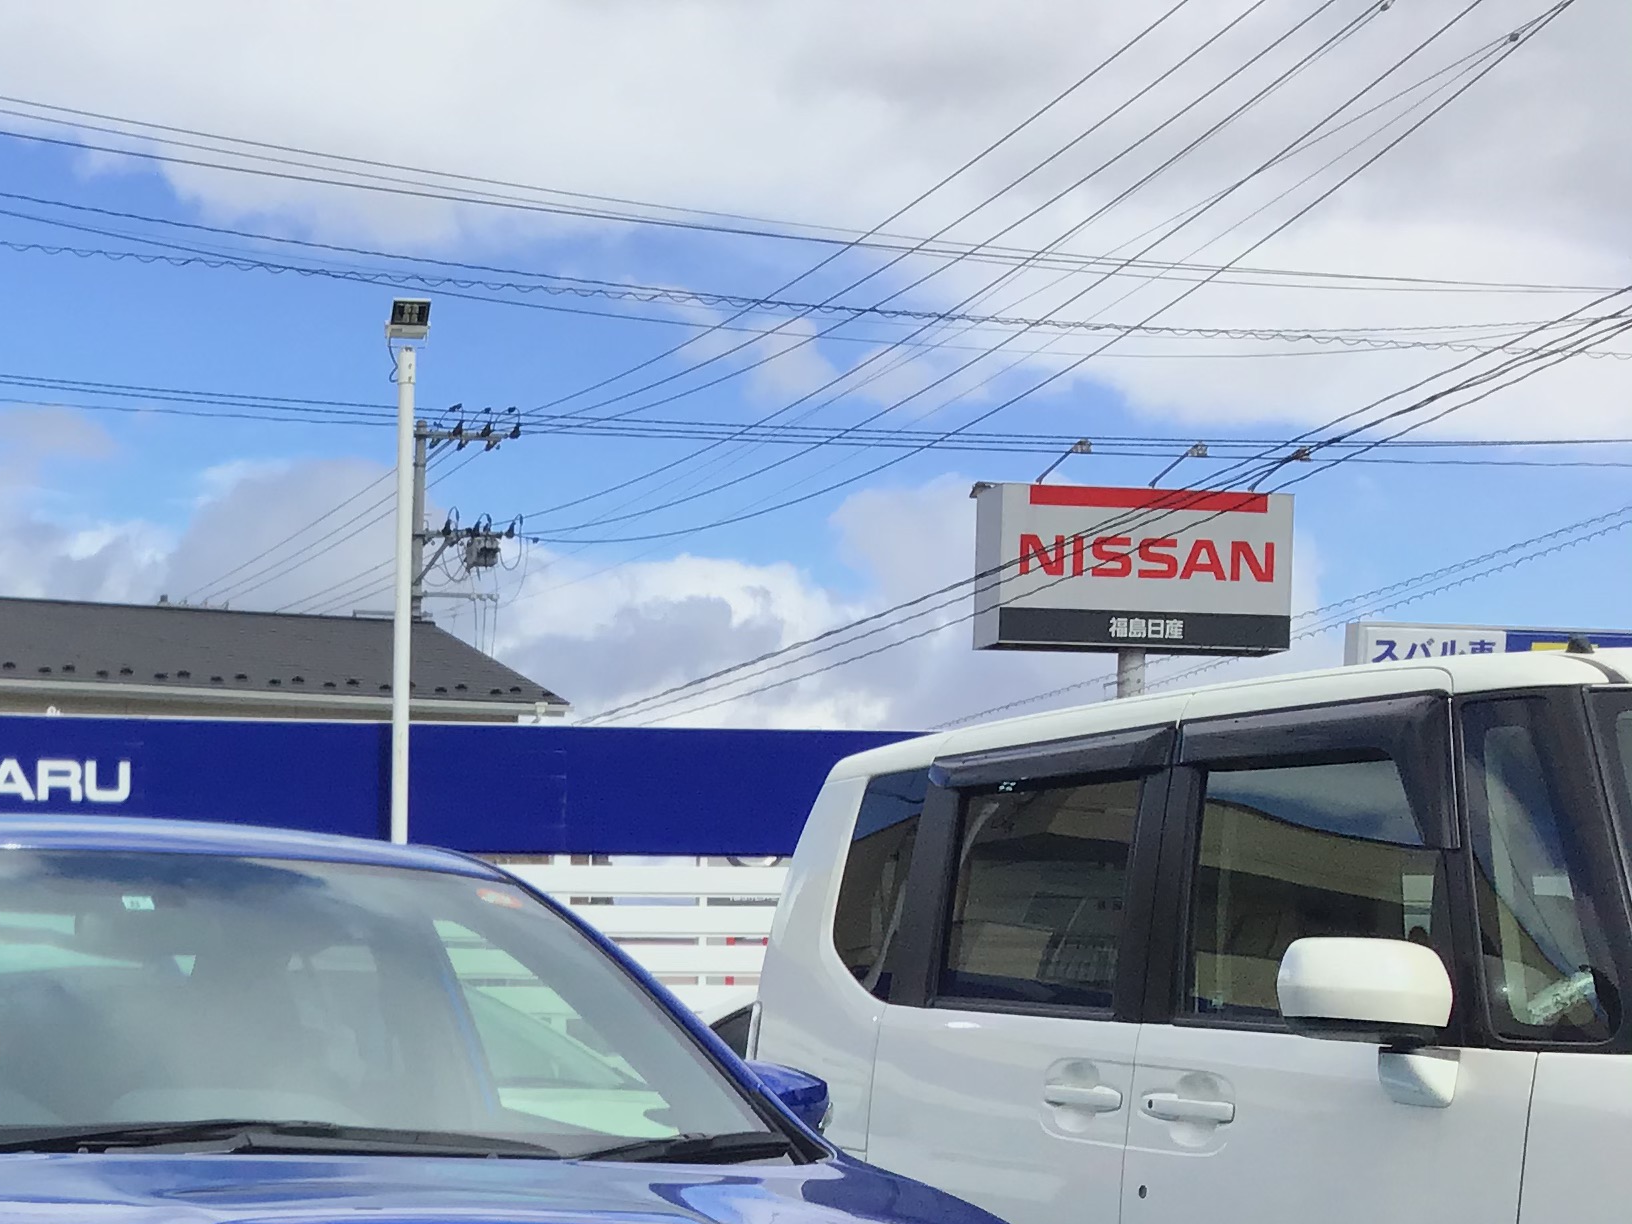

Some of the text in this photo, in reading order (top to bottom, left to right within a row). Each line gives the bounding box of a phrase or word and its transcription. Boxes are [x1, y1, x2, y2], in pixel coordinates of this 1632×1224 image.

[1019, 533, 1275, 584] NISSAN
[1108, 616, 1184, 640] 福島日産
